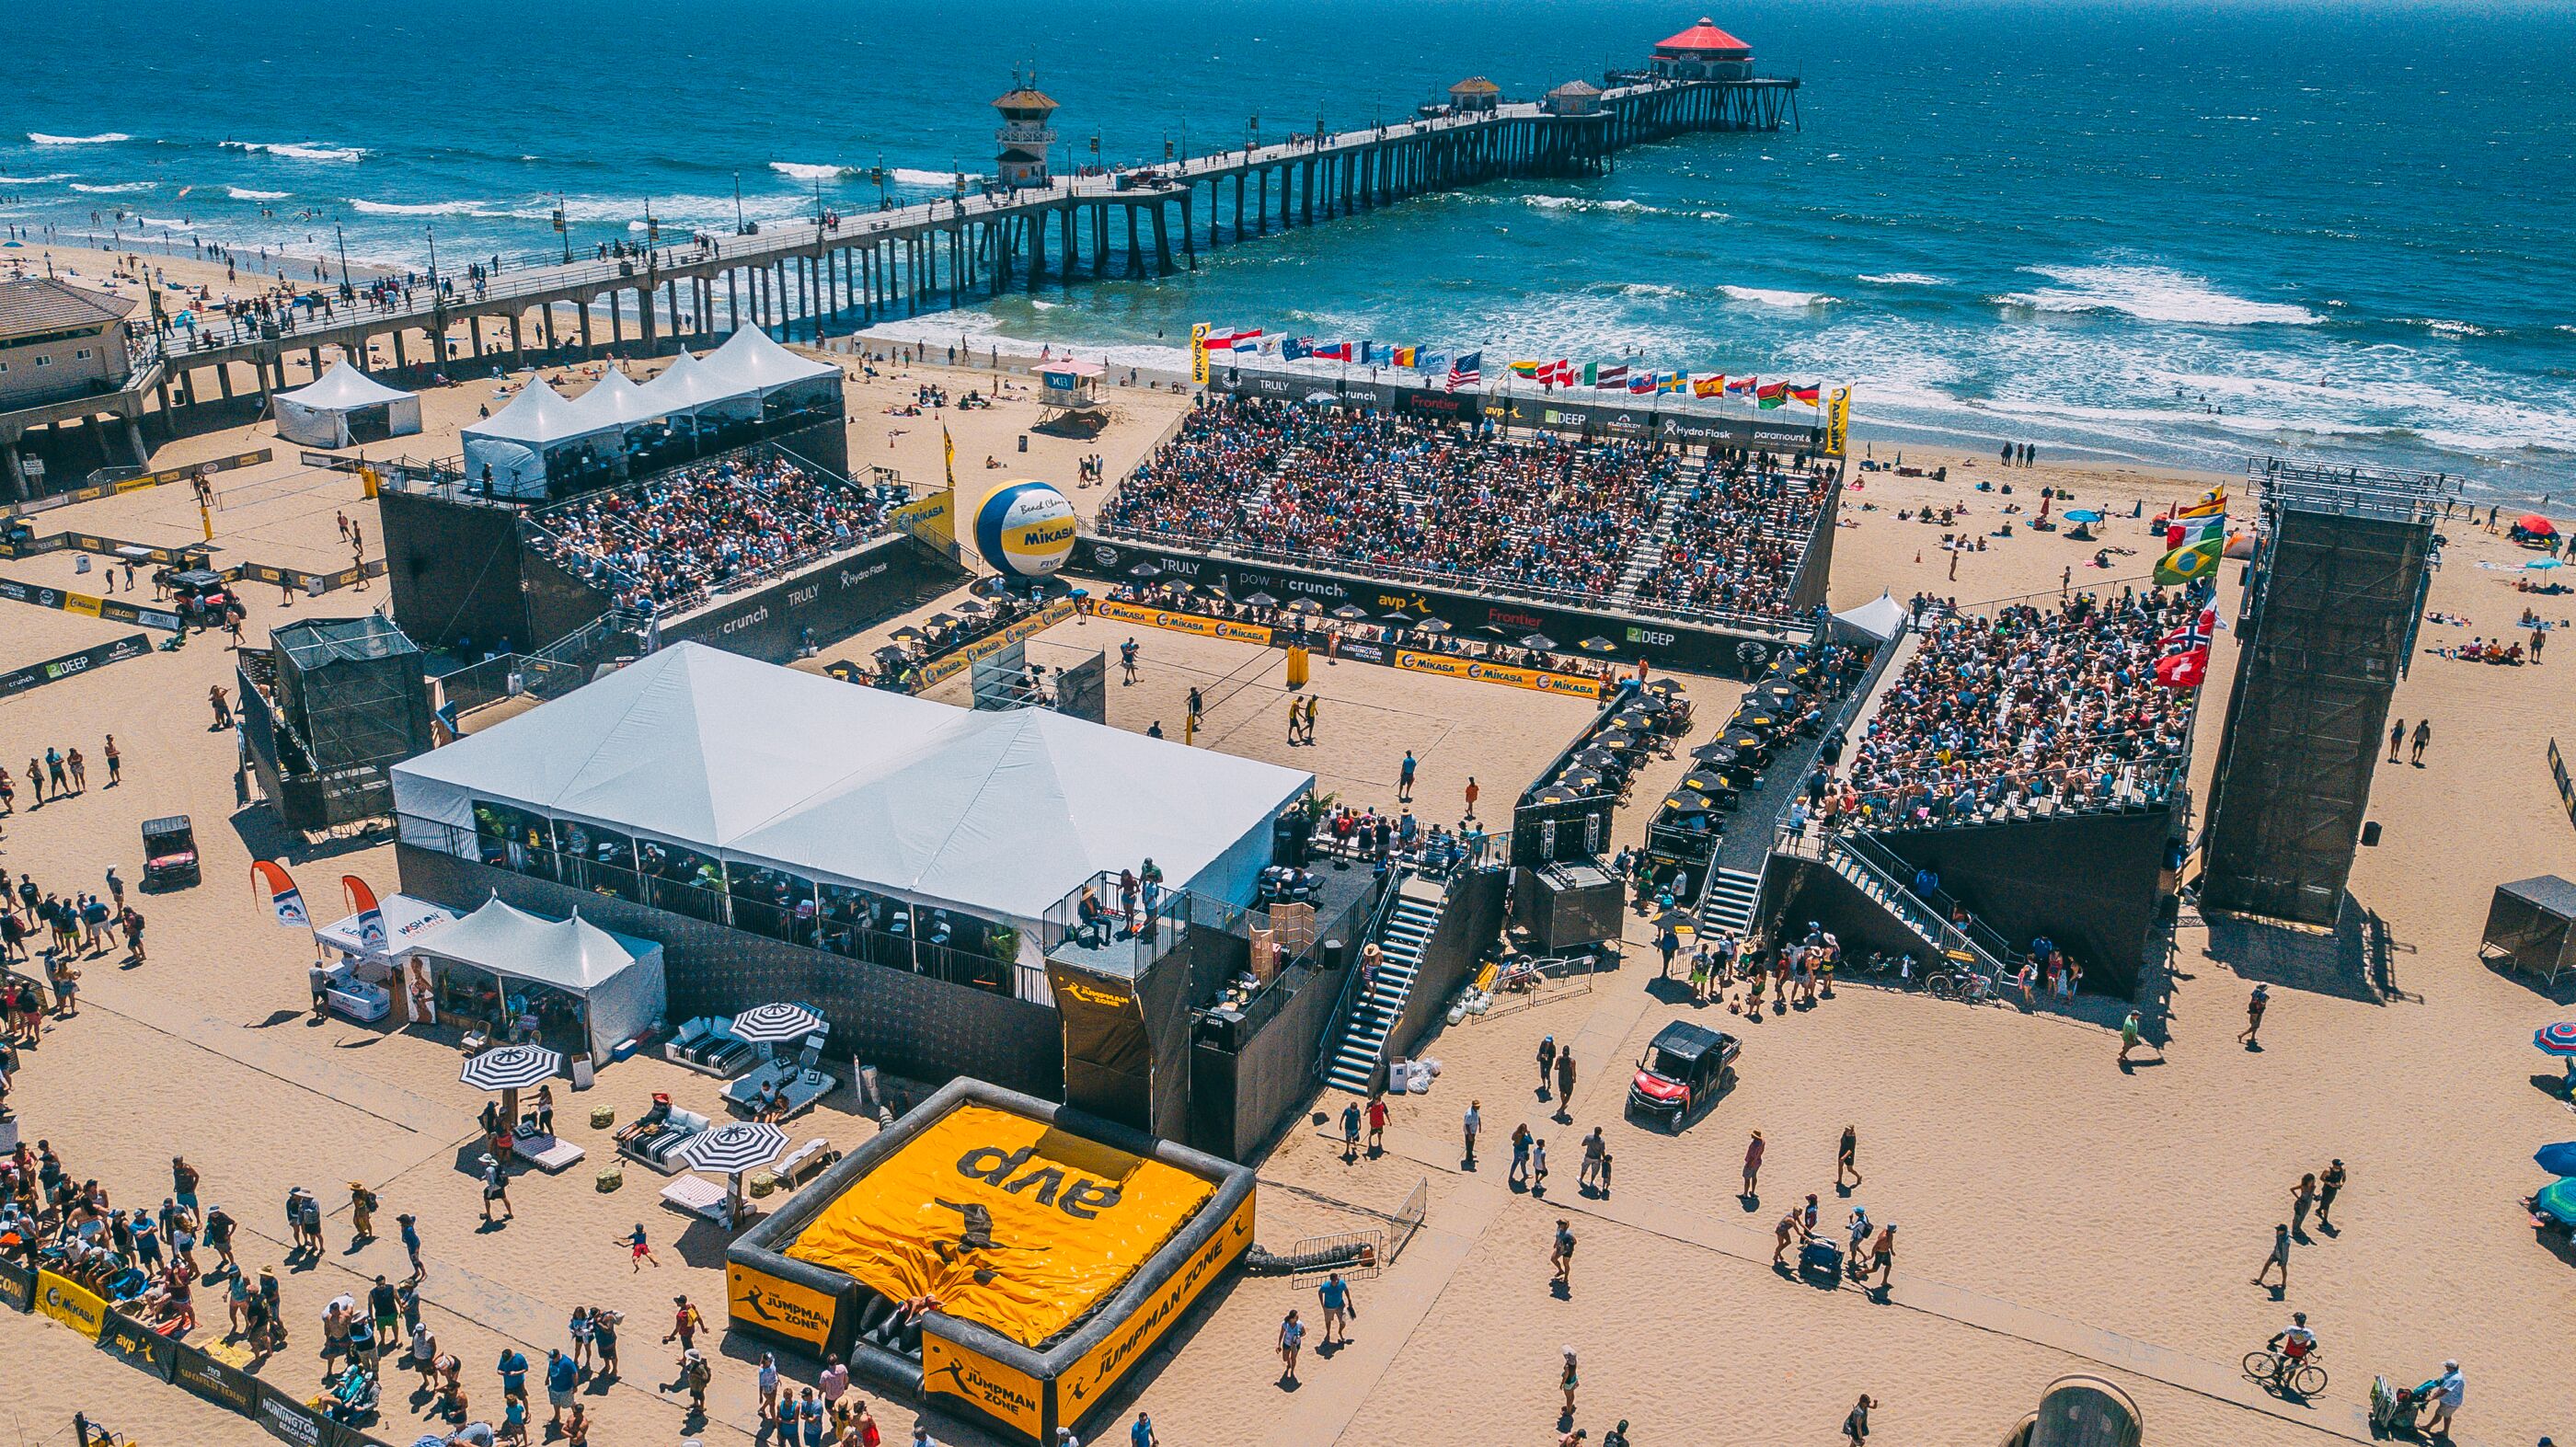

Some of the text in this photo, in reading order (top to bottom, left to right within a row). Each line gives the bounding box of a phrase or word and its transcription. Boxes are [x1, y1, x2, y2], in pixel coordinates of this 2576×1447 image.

[1259, 379, 1289, 392] TRULY
[1410, 395, 1459, 410] Frontier
[1485, 407, 1505, 417] avp
[1558, 411, 1586, 425] DEEP
[1677, 426, 1731, 440] Hydro Flask
[1754, 431, 1805, 442] paramount
[849, 561, 888, 585] Hydro Flask
[1161, 557, 1200, 575] TRULY
[788, 583, 820, 607] TRULY
[1288, 580, 1343, 598] crunch
[1378, 593, 1407, 611] avp
[723, 604, 769, 635] crunch
[1487, 607, 1544, 627] Frontier
[1641, 630, 1675, 647] DEEP
[60, 656, 88, 674] DEEP
[8, 674, 35, 688] crunch
[1080, 988, 1130, 1004] JUMPMAN
[1094, 996, 1120, 1007] ZONE
[957, 1145, 1121, 1221] avp
[765, 1296, 830, 1328] JUMPMAN
[1094, 1236, 1224, 1384] JUMPMAN ZONE
[784, 1312, 820, 1331] ZONE
[116, 1333, 135, 1355] avp
[965, 1372, 1036, 1413] JUMPMAN
[984, 1390, 1019, 1416] ZONE
[262, 1397, 319, 1439] HUNTINGTON
[279, 1421, 317, 1446] BEACH OPEN
